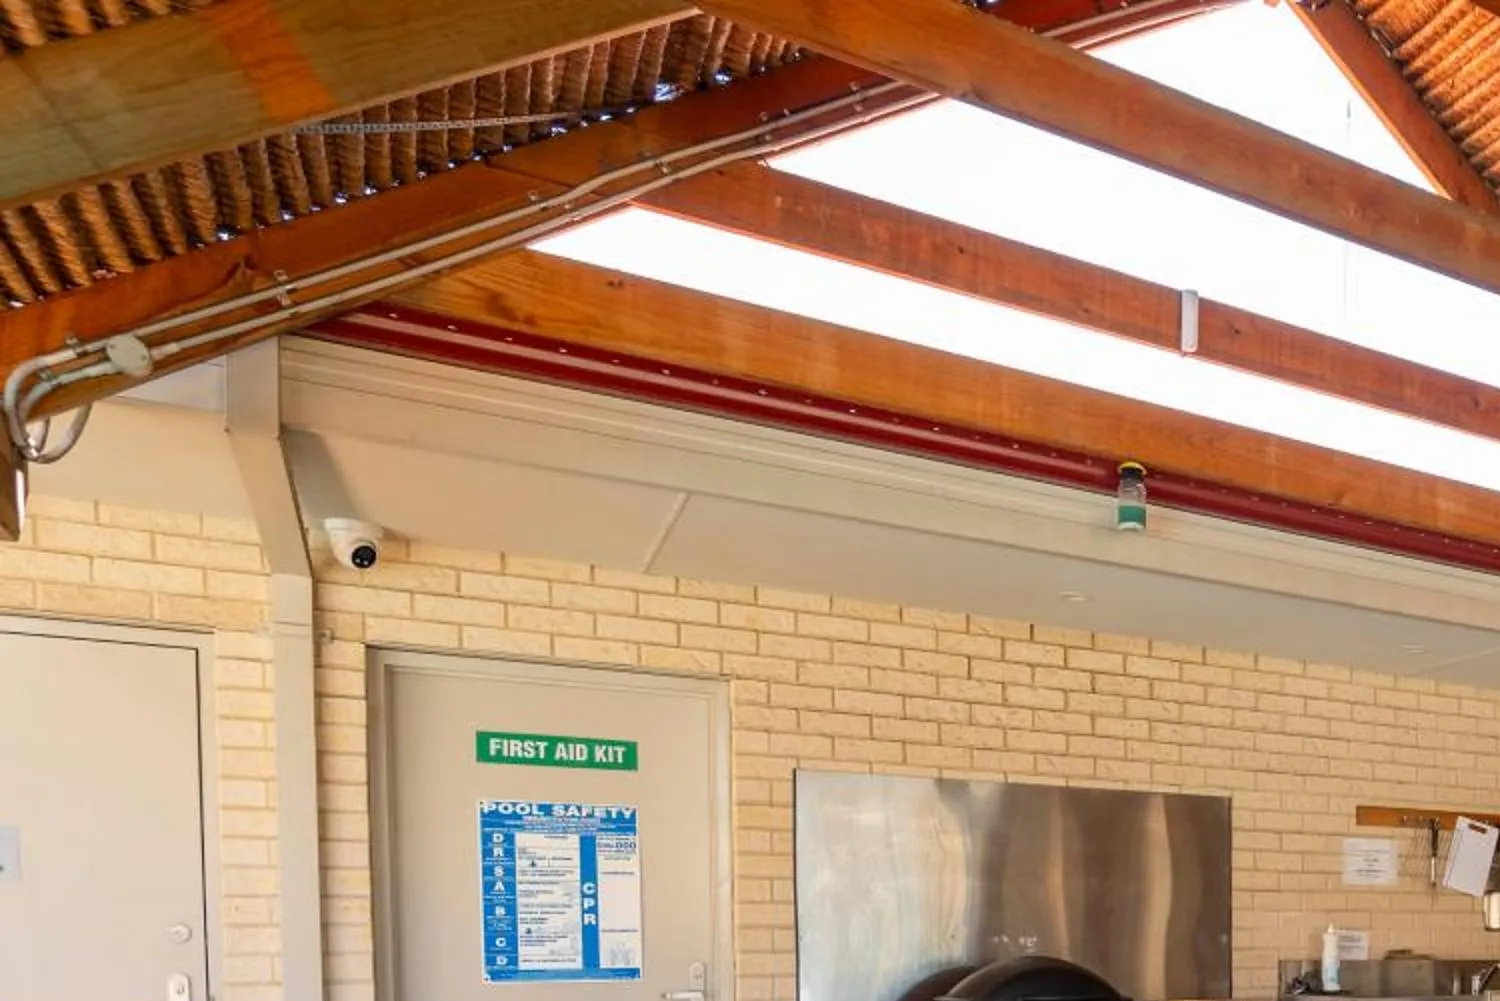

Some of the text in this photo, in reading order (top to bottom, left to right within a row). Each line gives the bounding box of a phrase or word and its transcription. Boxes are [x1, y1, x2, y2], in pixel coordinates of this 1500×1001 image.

[488, 737, 627, 763] FIRST AID KIT
[483, 802, 635, 819] POOL SAFETY
[492, 833, 504, 843] D
[493, 882, 505, 891] A
